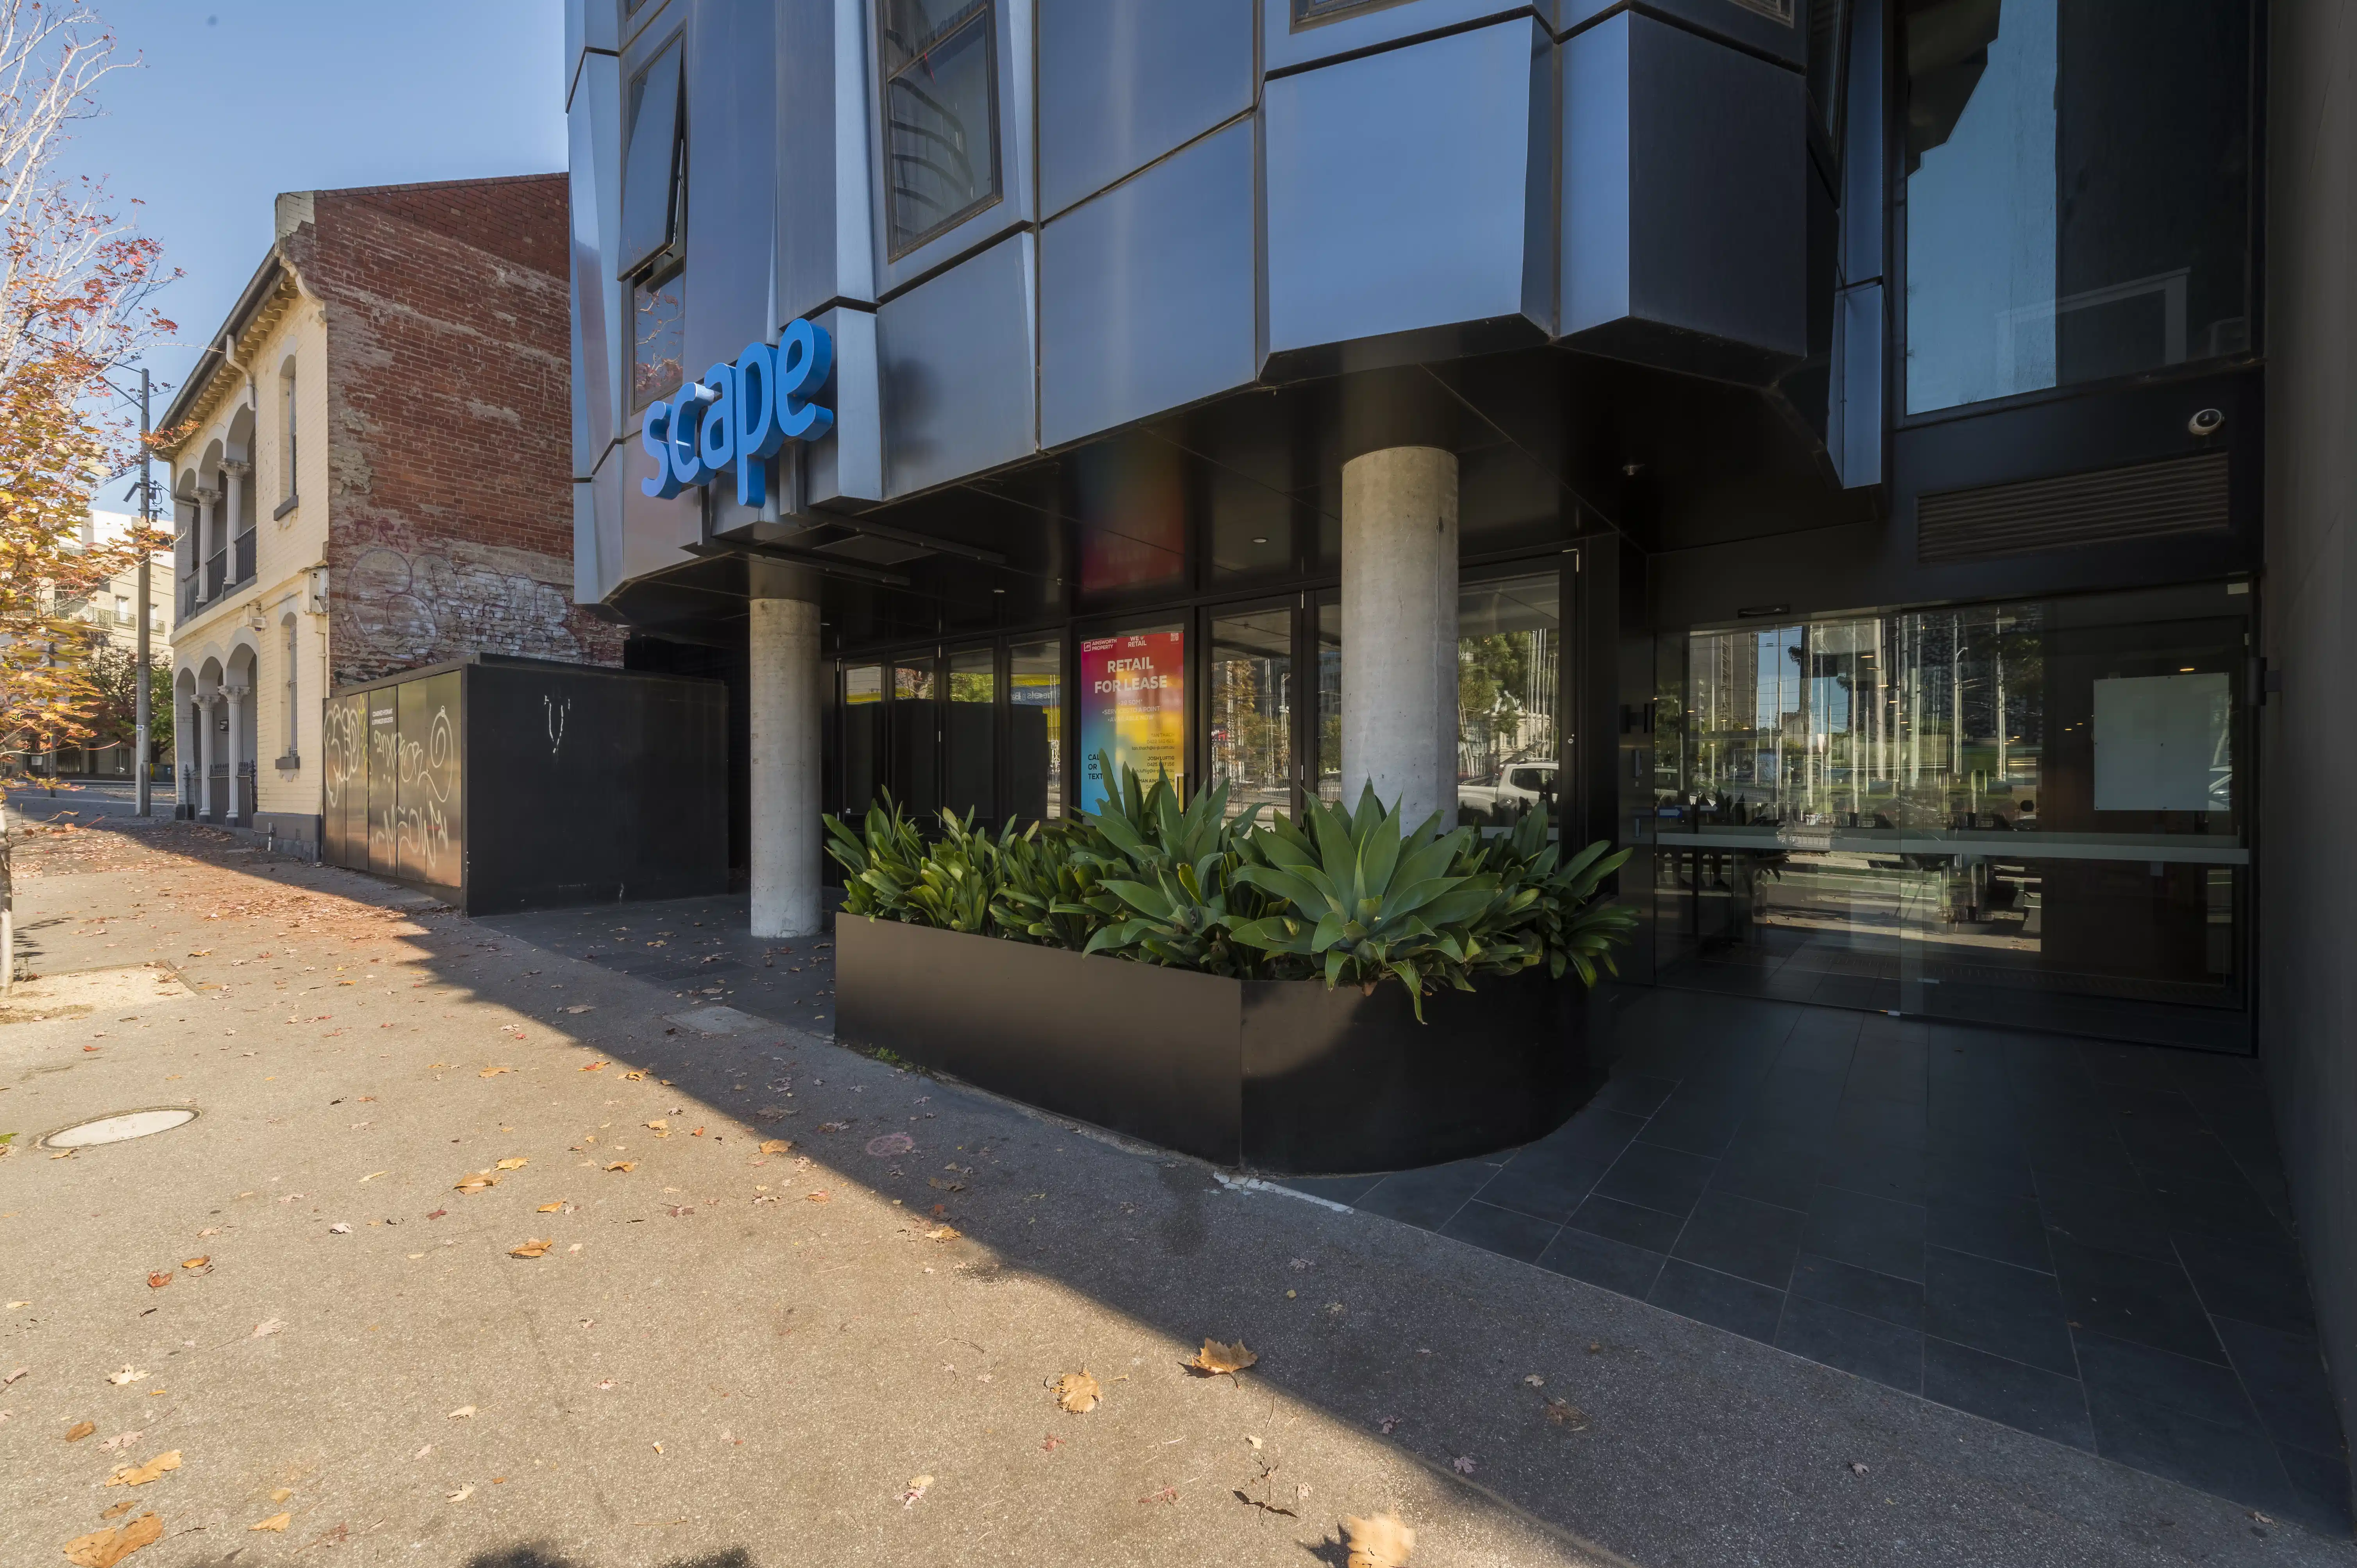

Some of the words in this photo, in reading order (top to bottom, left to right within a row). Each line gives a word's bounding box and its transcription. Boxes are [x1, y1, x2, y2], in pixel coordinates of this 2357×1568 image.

[641, 318, 833, 508] scape
[1107, 657, 1153, 673] RETAIL
[1095, 680, 1121, 693] FOR
[1124, 675, 1167, 691] LEASE
